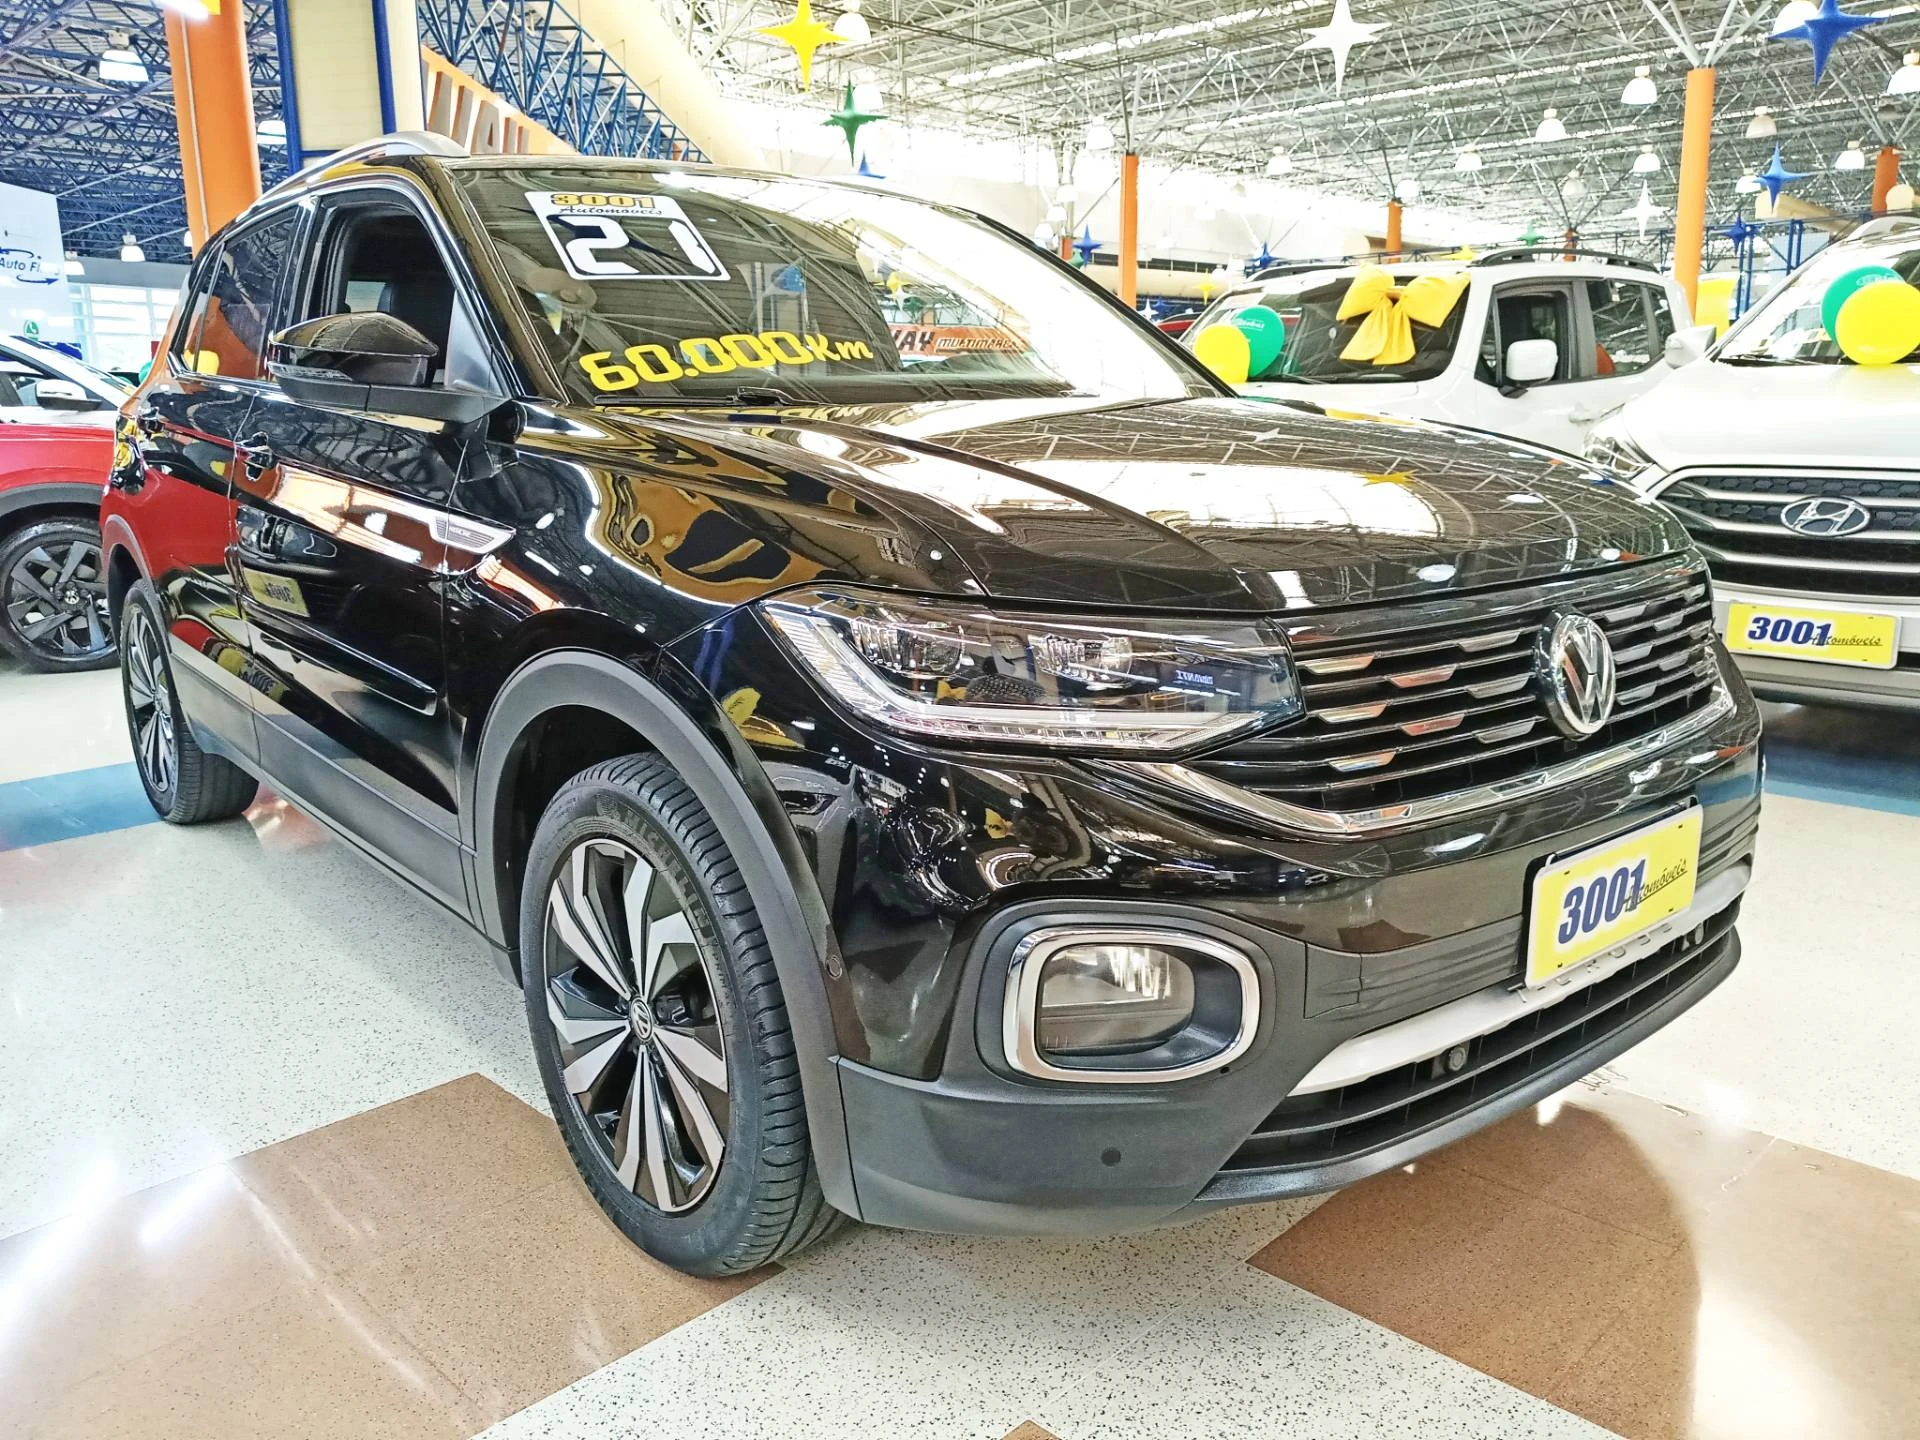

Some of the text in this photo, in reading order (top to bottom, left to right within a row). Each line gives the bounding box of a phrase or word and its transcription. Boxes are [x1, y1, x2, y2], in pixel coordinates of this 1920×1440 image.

[551, 193, 656, 209] 3001
[558, 215, 716, 274] 21
[1748, 616, 1832, 646] 3001
[1558, 859, 1646, 945] 3001
